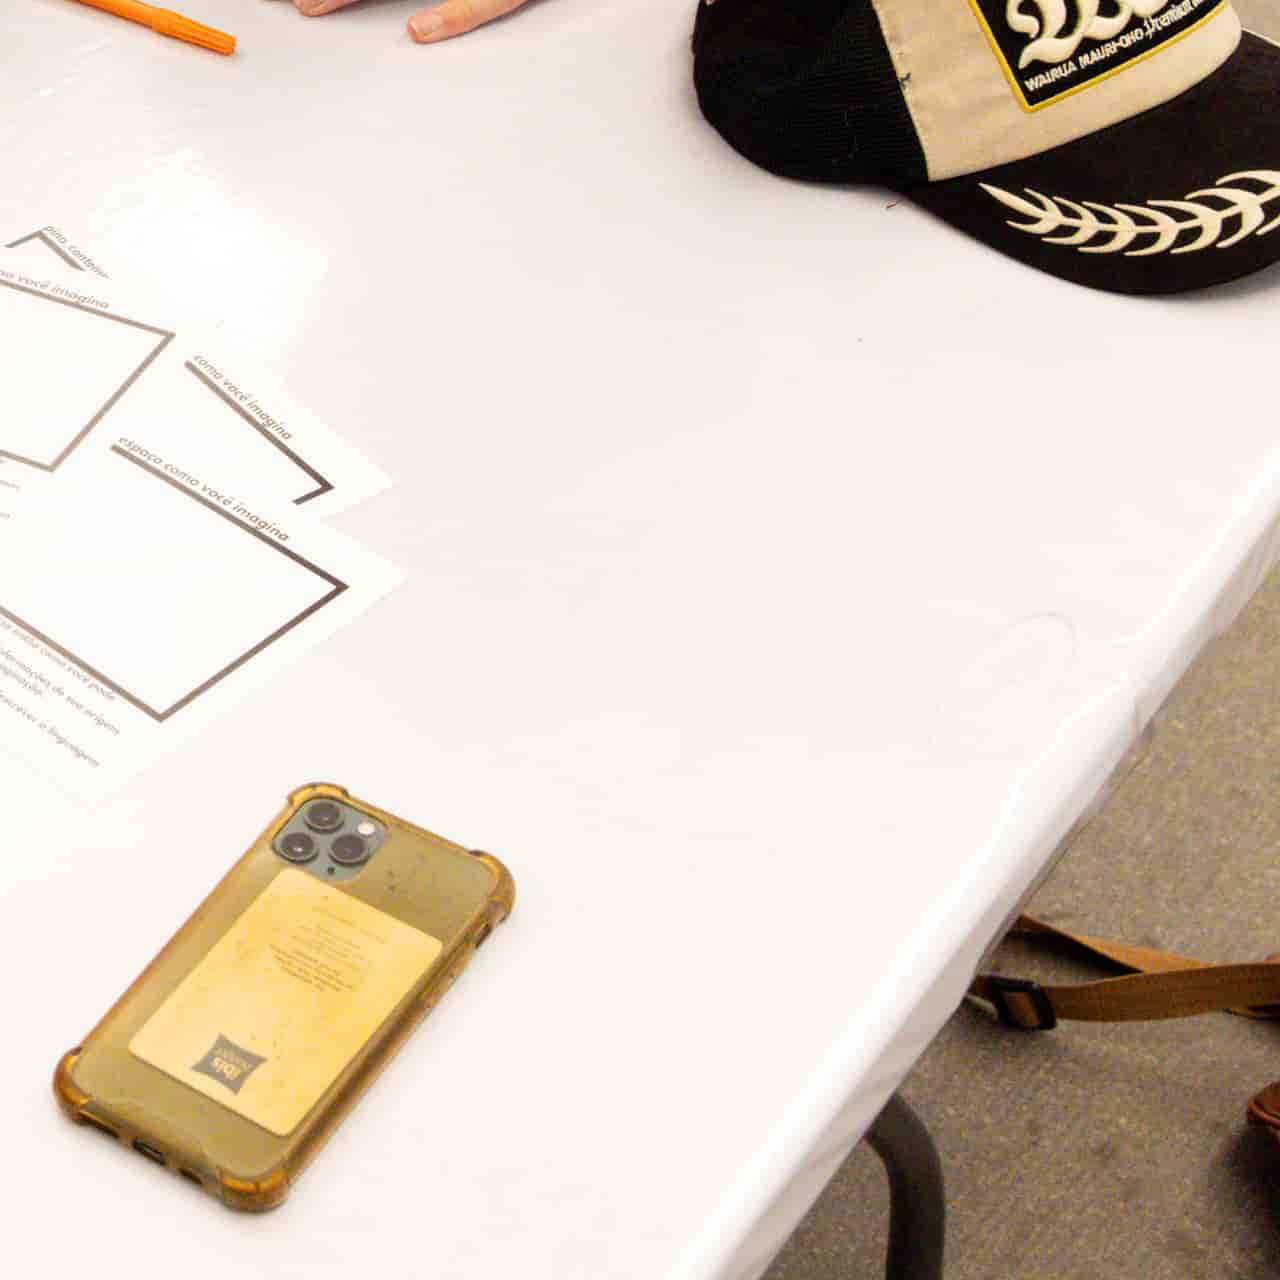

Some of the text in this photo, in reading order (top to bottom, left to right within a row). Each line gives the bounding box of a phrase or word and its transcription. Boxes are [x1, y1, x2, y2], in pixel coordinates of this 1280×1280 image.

[1024, 61, 1078, 92] WAIRUA
[190, 352, 297, 443] como você imagina
[116, 432, 292, 546] espaço como você imagina
